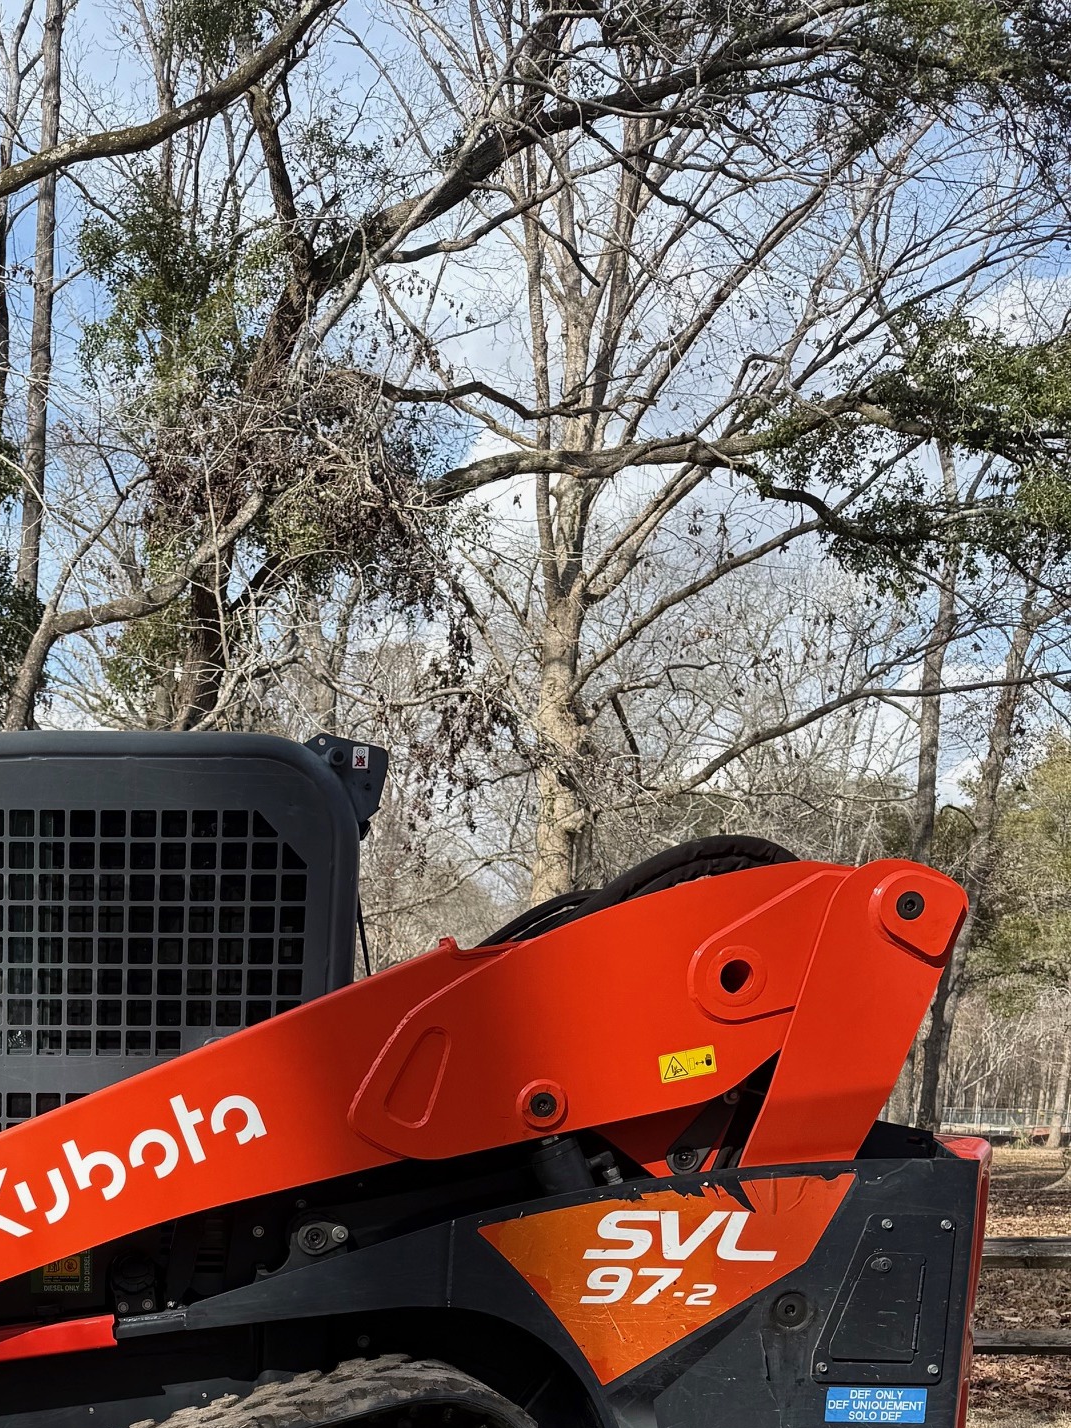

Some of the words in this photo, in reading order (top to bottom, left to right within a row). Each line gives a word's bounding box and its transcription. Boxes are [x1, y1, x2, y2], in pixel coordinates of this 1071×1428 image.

[582, 1210, 778, 1262] SVL
[83, 1255, 91, 1275] DIESEL
[83, 1276, 91, 1292] SOLO
[579, 1266, 717, 1306] 97-2
[850, 1389, 871, 1400] DEF
[875, 1390, 904, 1400] ONLY
[828, 1400, 850, 1410] DEF
[852, 1400, 924, 1411] UNIQUEMENT
[849, 1411, 877, 1421] SOLO
[880, 1411, 903, 1421] DEF
